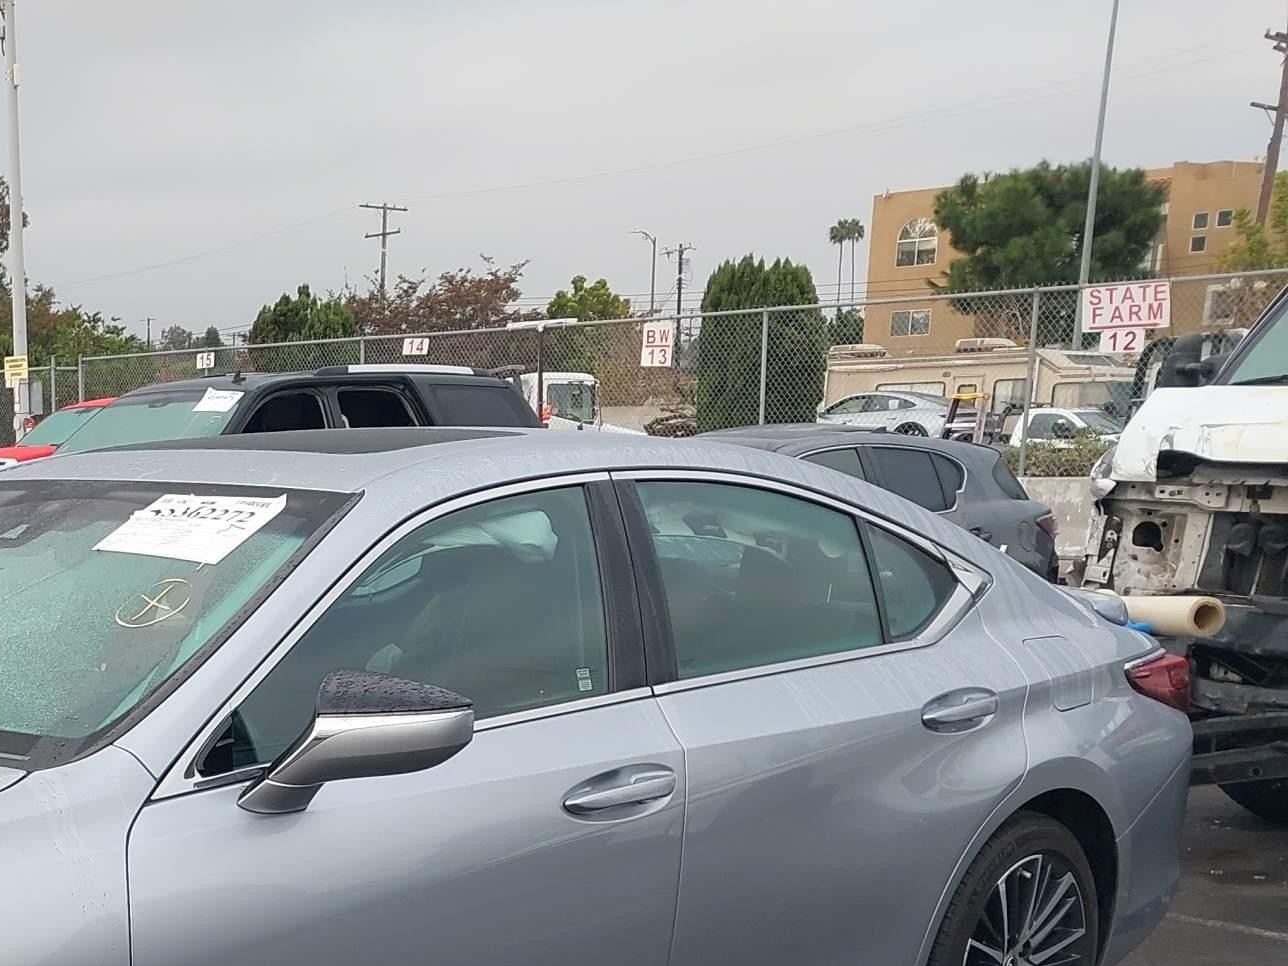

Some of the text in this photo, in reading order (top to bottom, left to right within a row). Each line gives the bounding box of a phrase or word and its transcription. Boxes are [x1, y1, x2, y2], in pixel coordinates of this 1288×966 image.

[1089, 284, 1167, 306] STATE
[1092, 303, 1163, 324] FARM
[647, 329, 670, 344] BW
[1108, 331, 1137, 351] 12
[408, 339, 424, 354] 14
[199, 353, 212, 367] 15
[647, 349, 667, 364] 13
